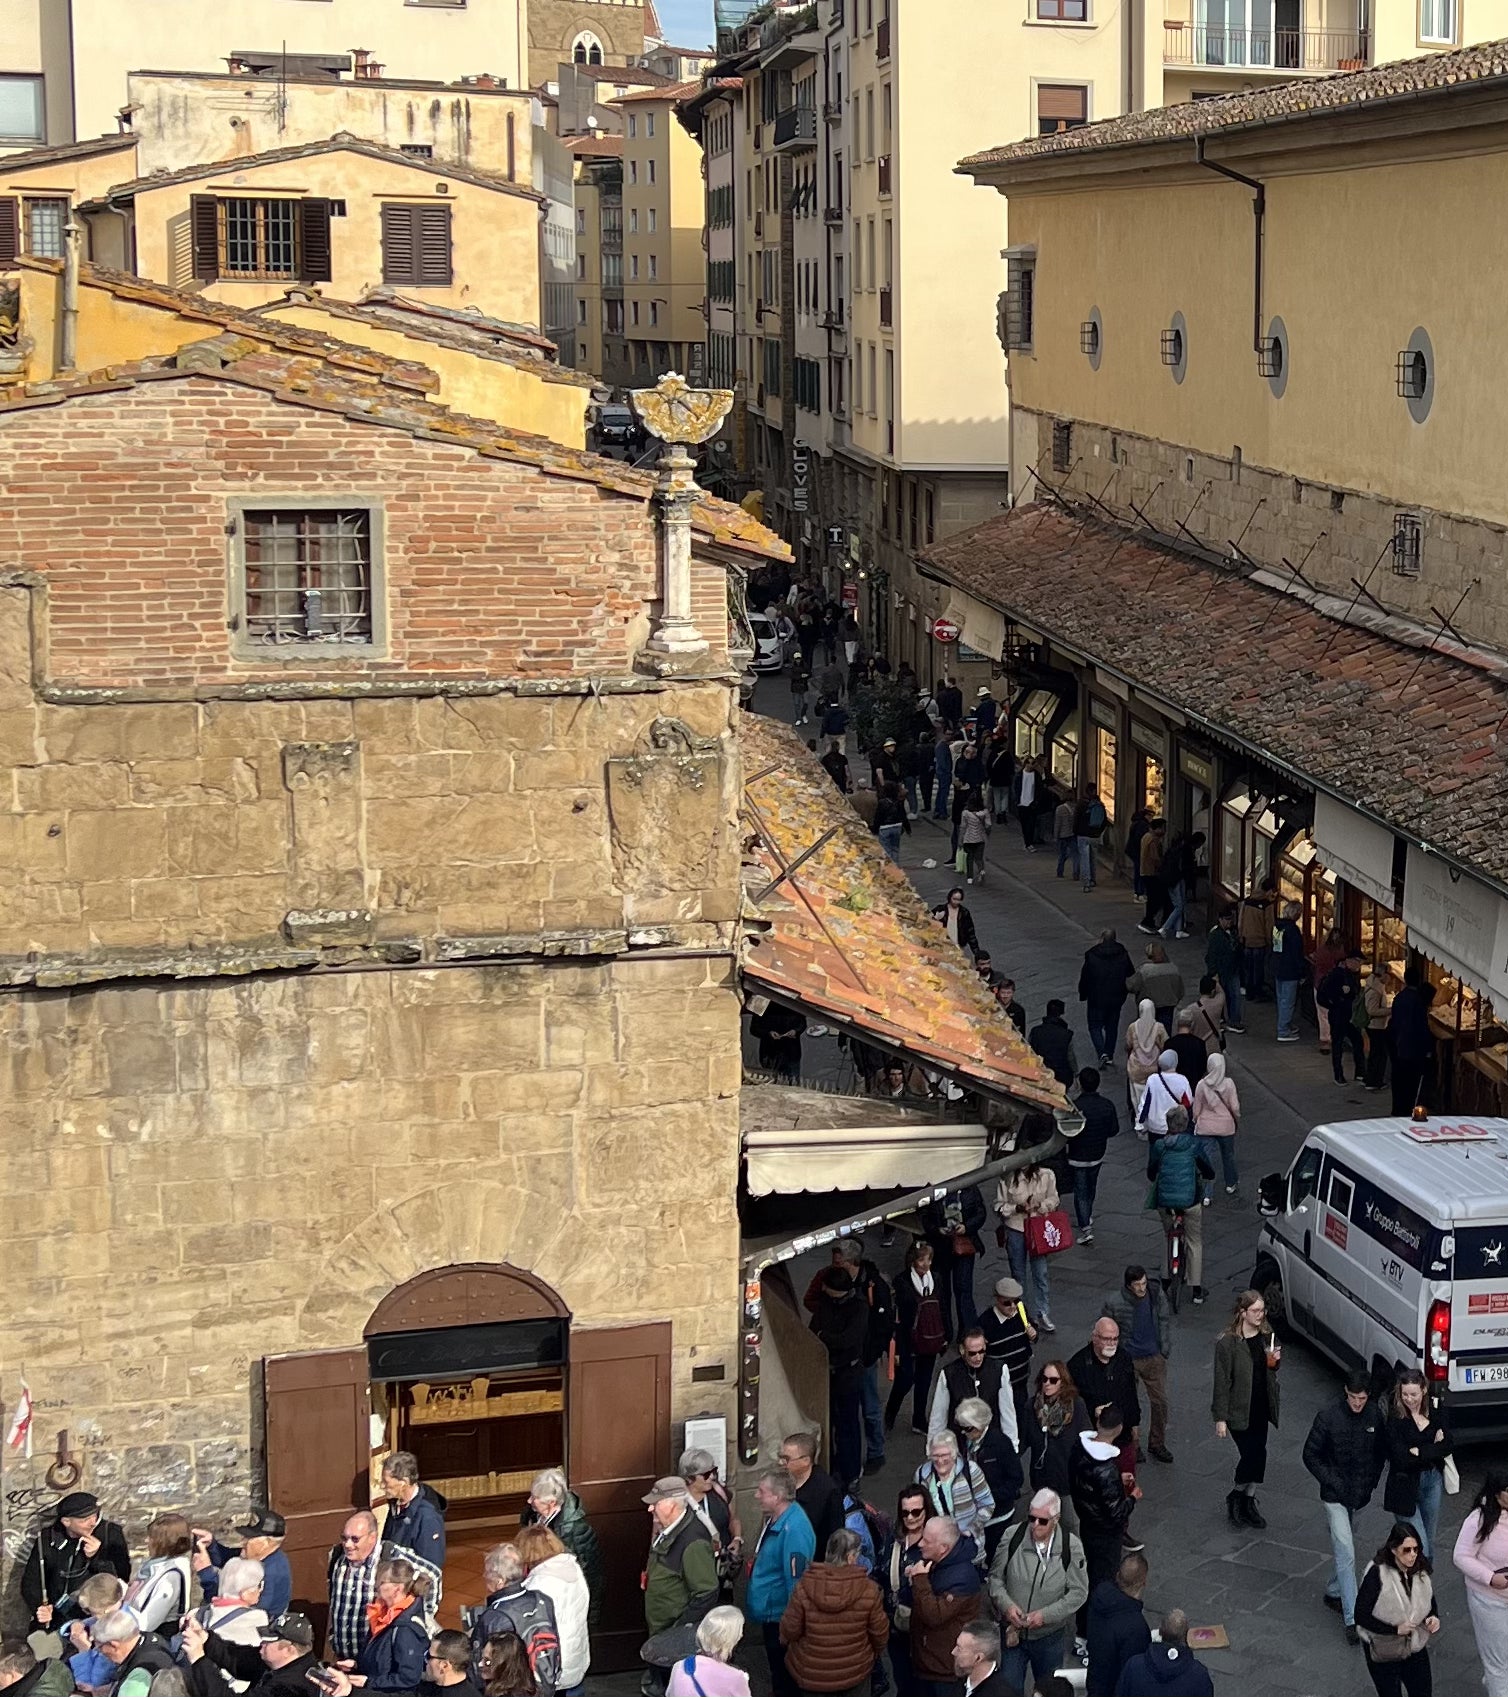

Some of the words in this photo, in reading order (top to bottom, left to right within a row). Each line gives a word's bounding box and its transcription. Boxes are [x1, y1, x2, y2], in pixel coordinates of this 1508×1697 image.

[793, 438, 809, 512] GLOVES
[1408, 1123, 1489, 1138] 640
[1389, 1259, 1405, 1281] BTV
